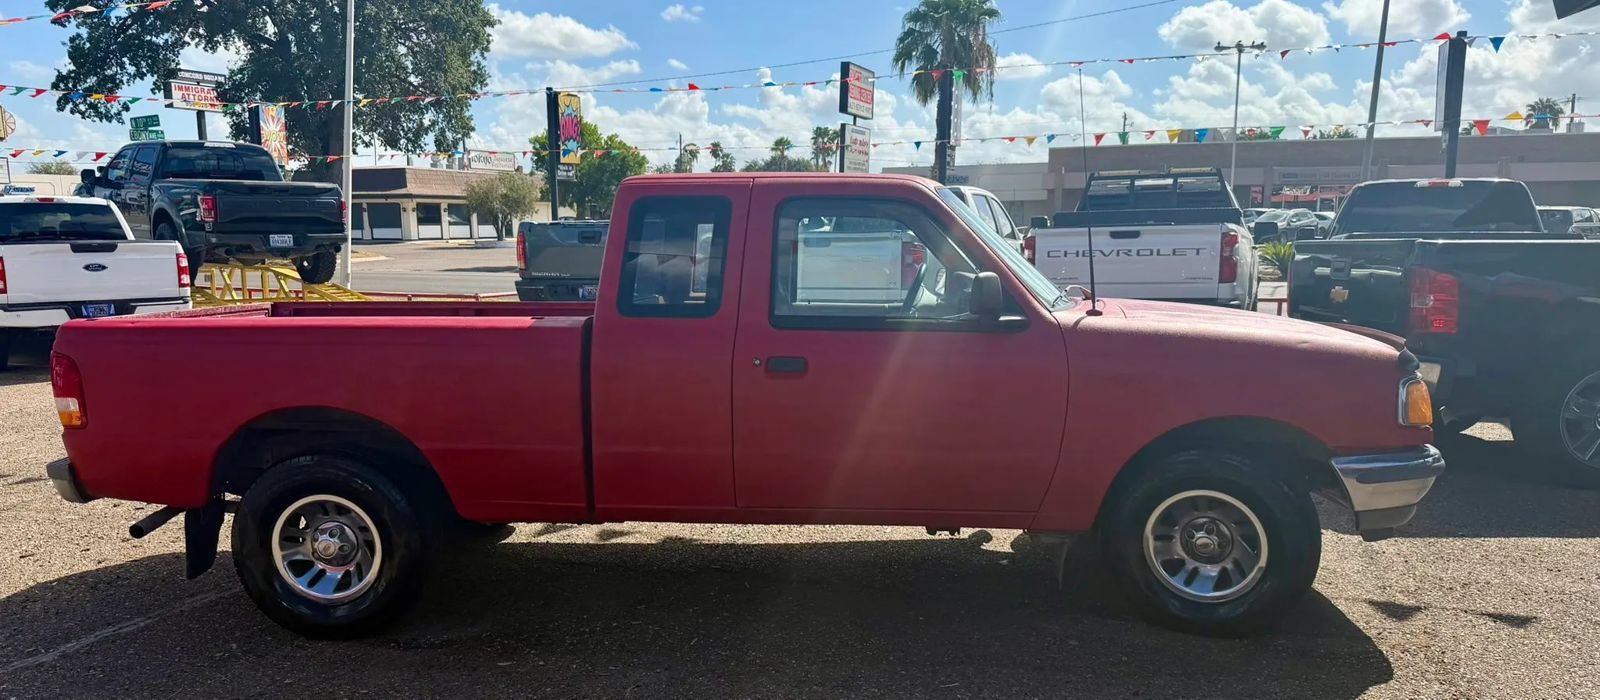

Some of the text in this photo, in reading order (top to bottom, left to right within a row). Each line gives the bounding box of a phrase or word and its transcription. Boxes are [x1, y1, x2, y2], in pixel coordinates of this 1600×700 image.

[174, 84, 215, 96] IMMIGRAT
[181, 93, 217, 102] ATTORN
[1047, 247, 1207, 258] CHEVROLET
